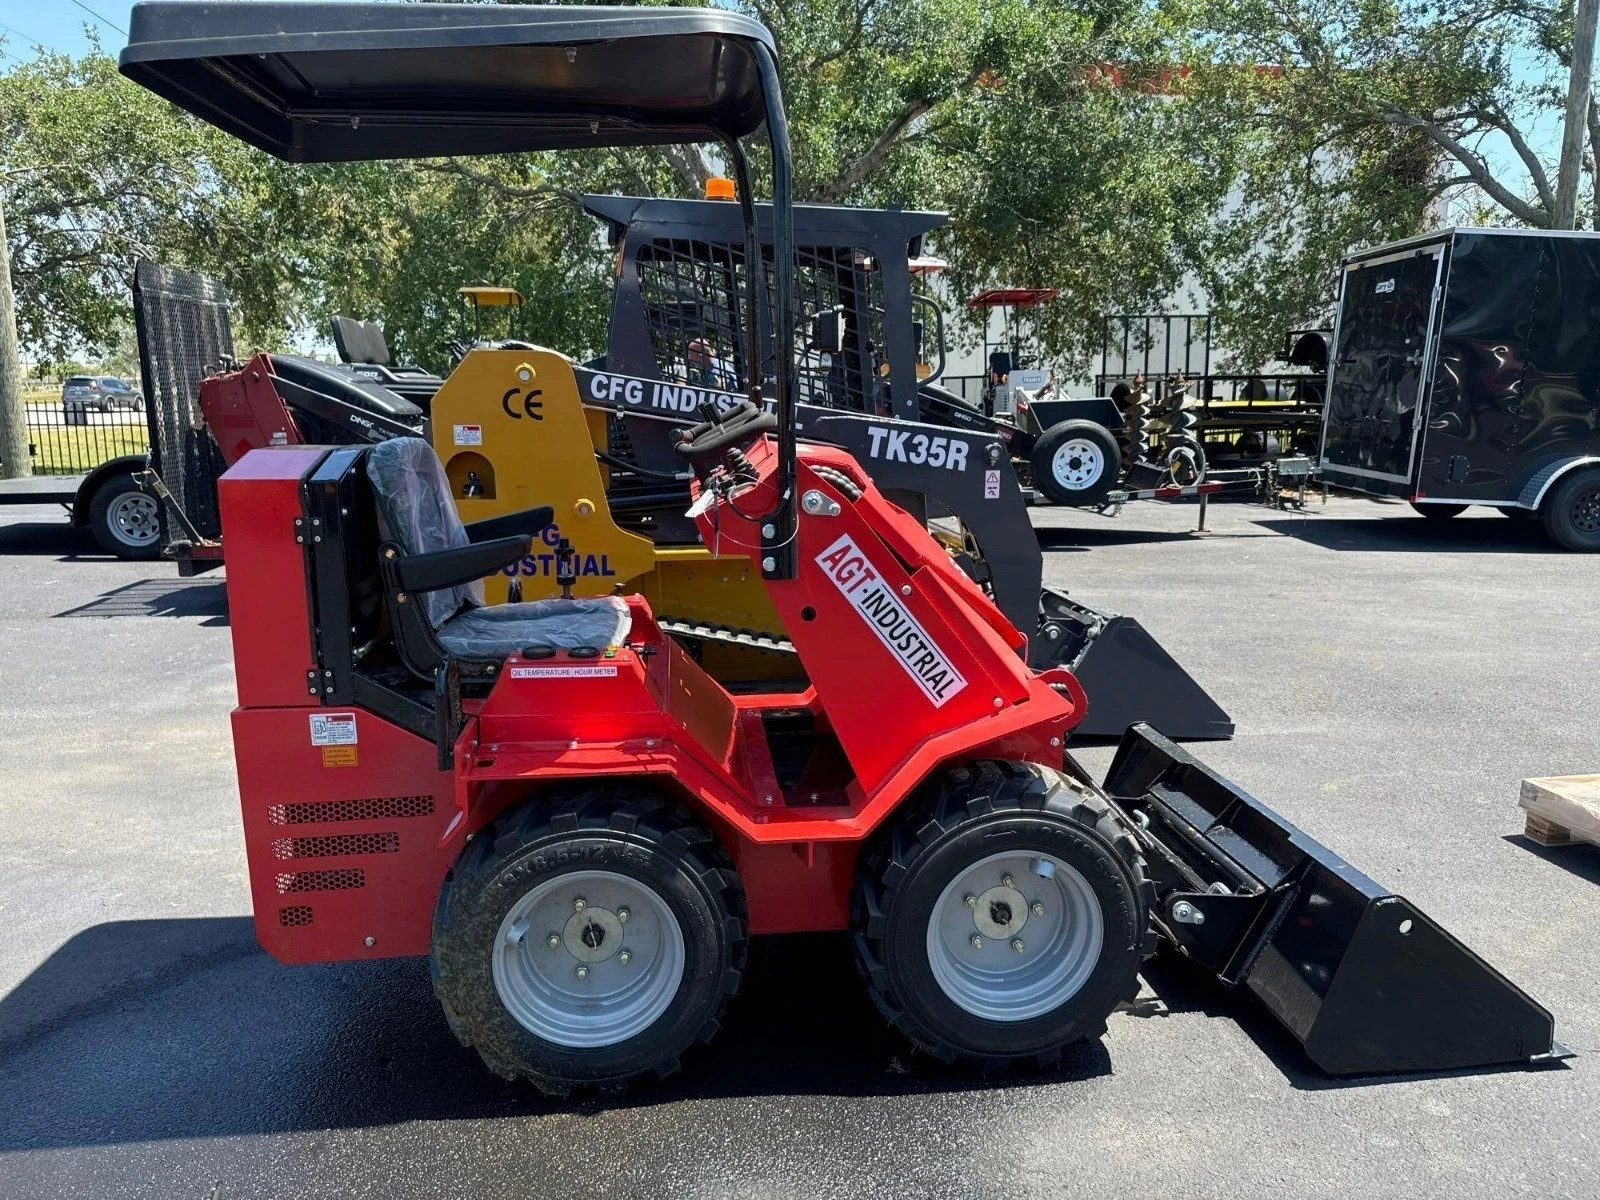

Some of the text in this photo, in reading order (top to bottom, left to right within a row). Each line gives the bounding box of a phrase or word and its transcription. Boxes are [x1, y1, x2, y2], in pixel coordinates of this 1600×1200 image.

[590, 374, 643, 405] CFG
[867, 426, 970, 472] TK35R
[821, 544, 955, 699] AGT INDUSTRIAL
[574, 668, 593, 676] HOUR
